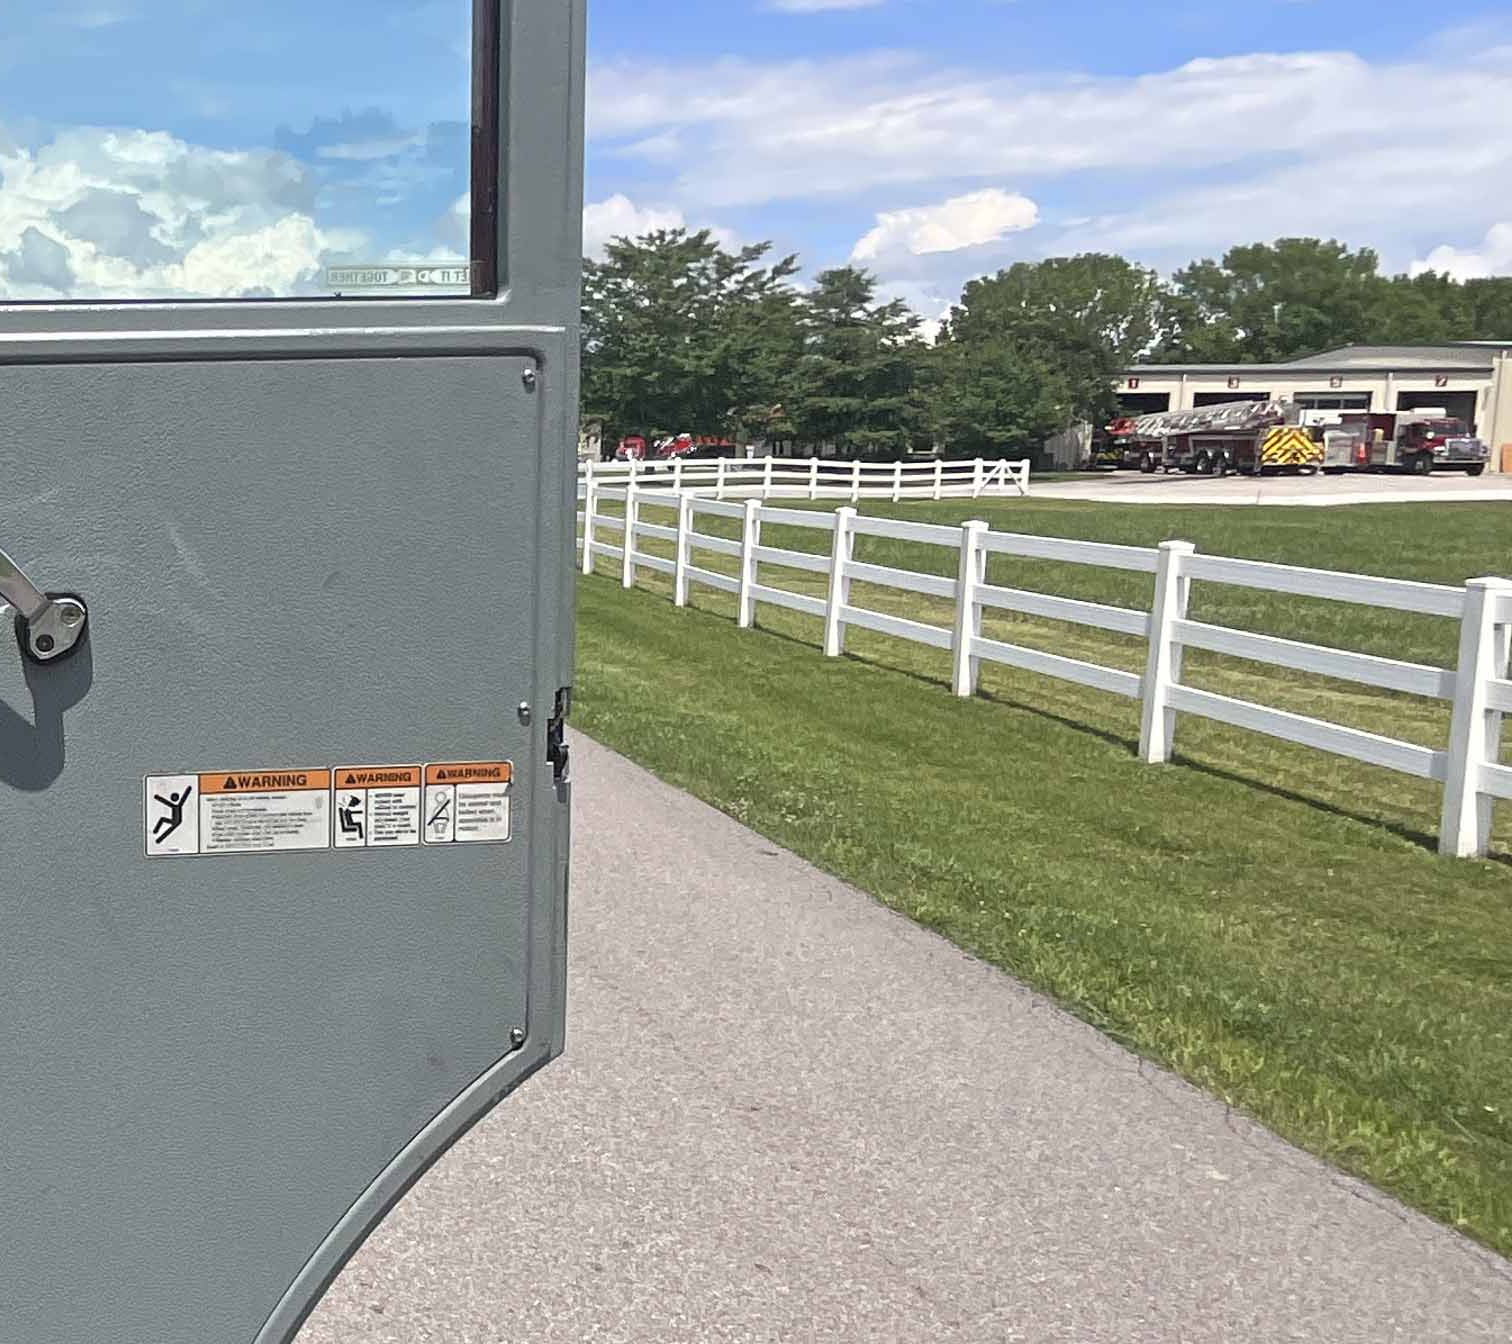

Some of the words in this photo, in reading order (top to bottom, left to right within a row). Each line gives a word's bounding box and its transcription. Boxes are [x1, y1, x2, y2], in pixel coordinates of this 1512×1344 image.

[356, 772, 411, 784] WARNING
[447, 768, 501, 778] WARNING
[237, 774, 308, 788] WARNING
